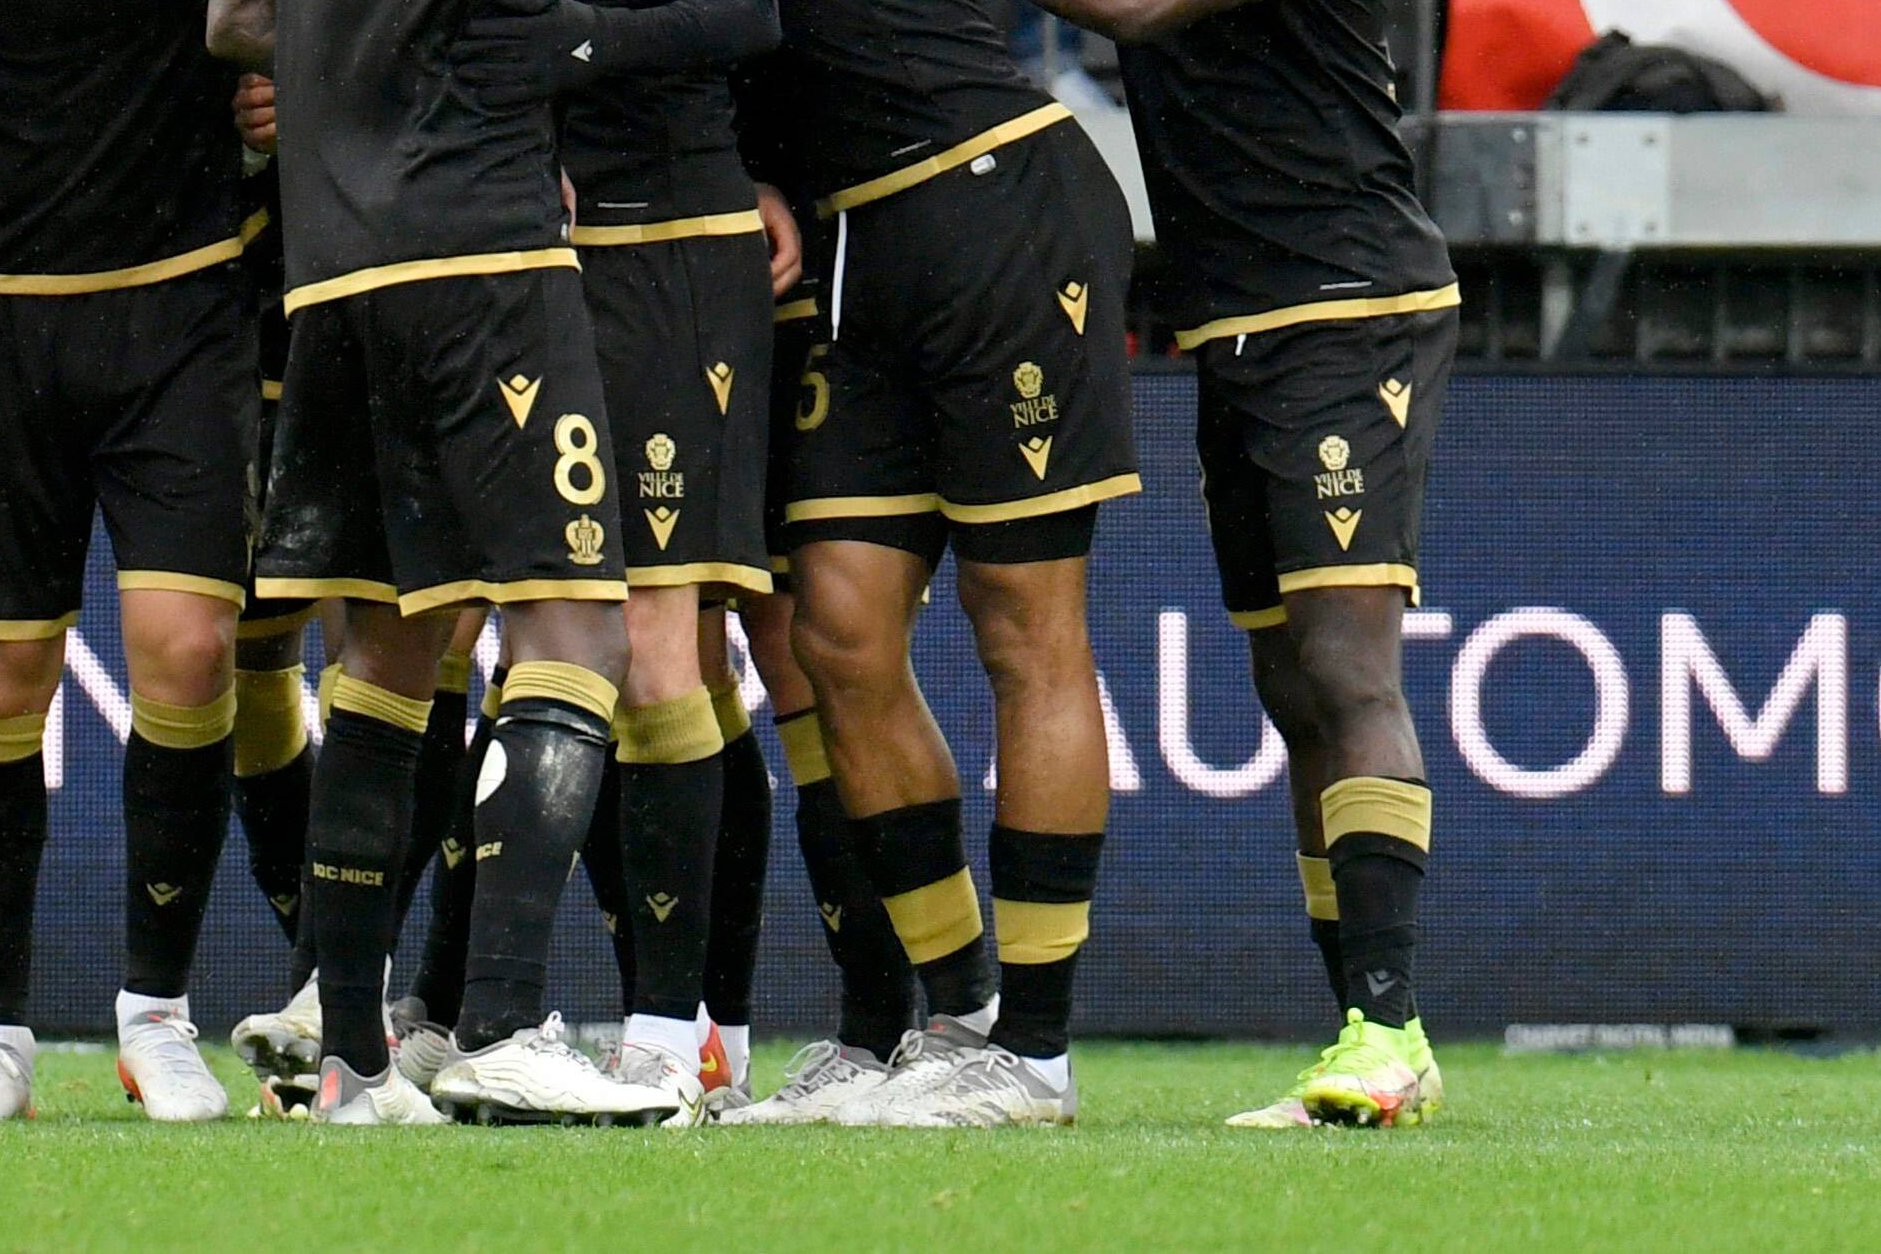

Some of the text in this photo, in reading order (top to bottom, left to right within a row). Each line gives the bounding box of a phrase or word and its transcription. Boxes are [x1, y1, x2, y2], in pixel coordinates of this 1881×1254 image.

[1014, 405, 1059, 428] NICE
[554, 413, 606, 505] 8
[639, 482, 685, 498] NICE
[1317, 480, 1365, 499] NICE
[341, 867, 384, 887] NICE
